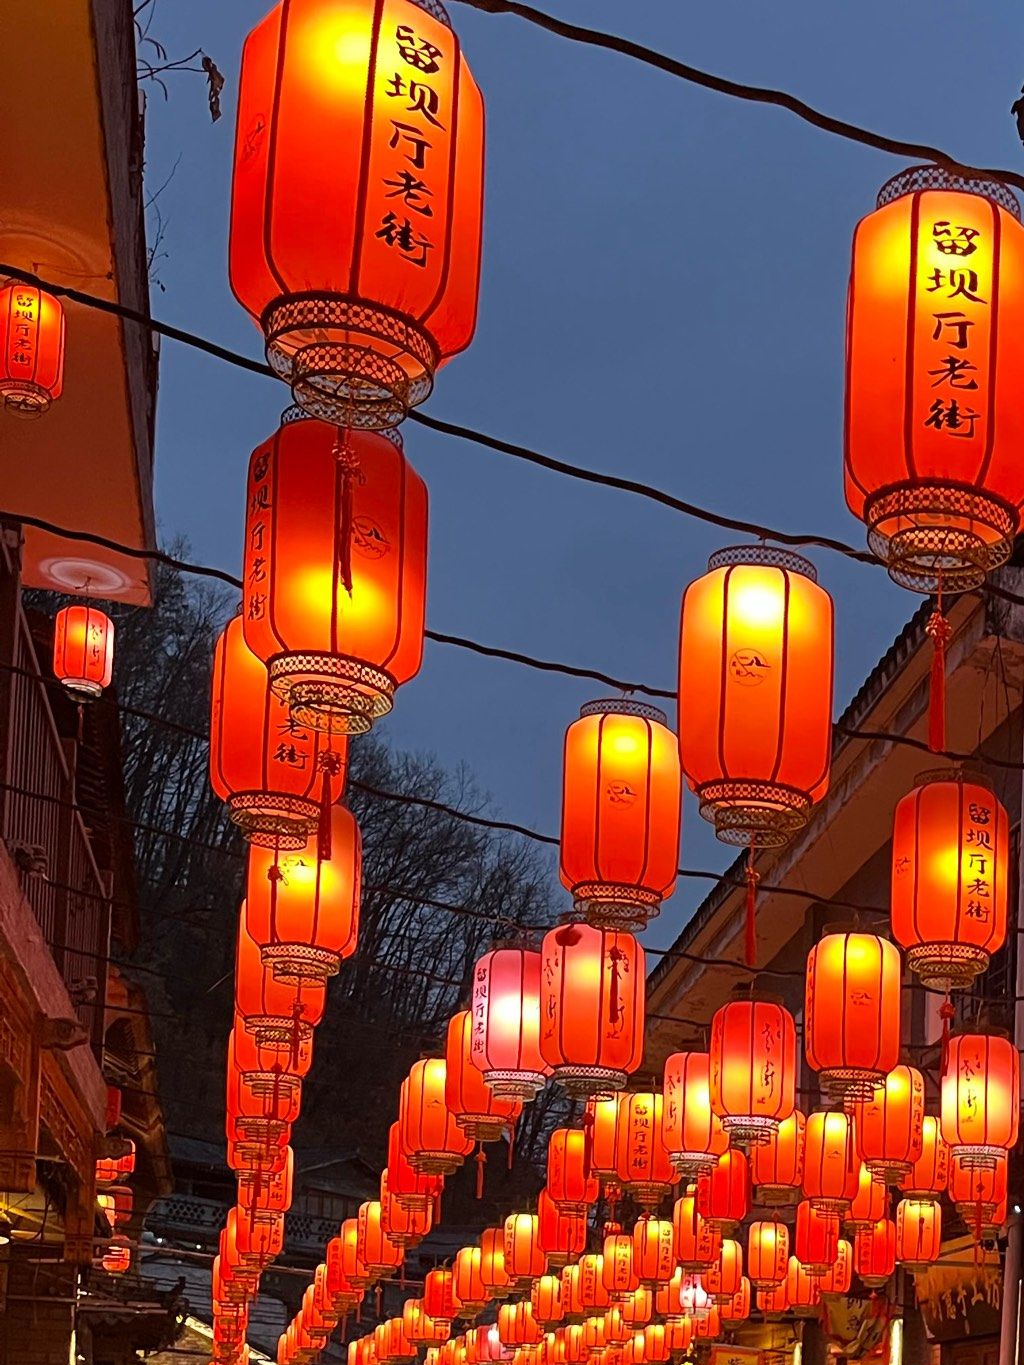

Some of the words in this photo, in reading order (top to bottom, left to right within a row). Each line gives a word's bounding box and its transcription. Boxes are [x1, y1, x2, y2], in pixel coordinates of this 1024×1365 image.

[375, 24, 447, 268] 留坝厅老街
[11, 294, 35, 368] 留坝厅老街
[924, 220, 988, 438] 留坝厅老街
[248, 451, 272, 621] 留坝厅老街
[273, 700, 310, 770] 老街
[965, 803, 994, 924] 留坝厅老街
[473, 967, 488, 1054] 留坝厅老街
[632, 1104, 650, 1170] 留坝厅老街
